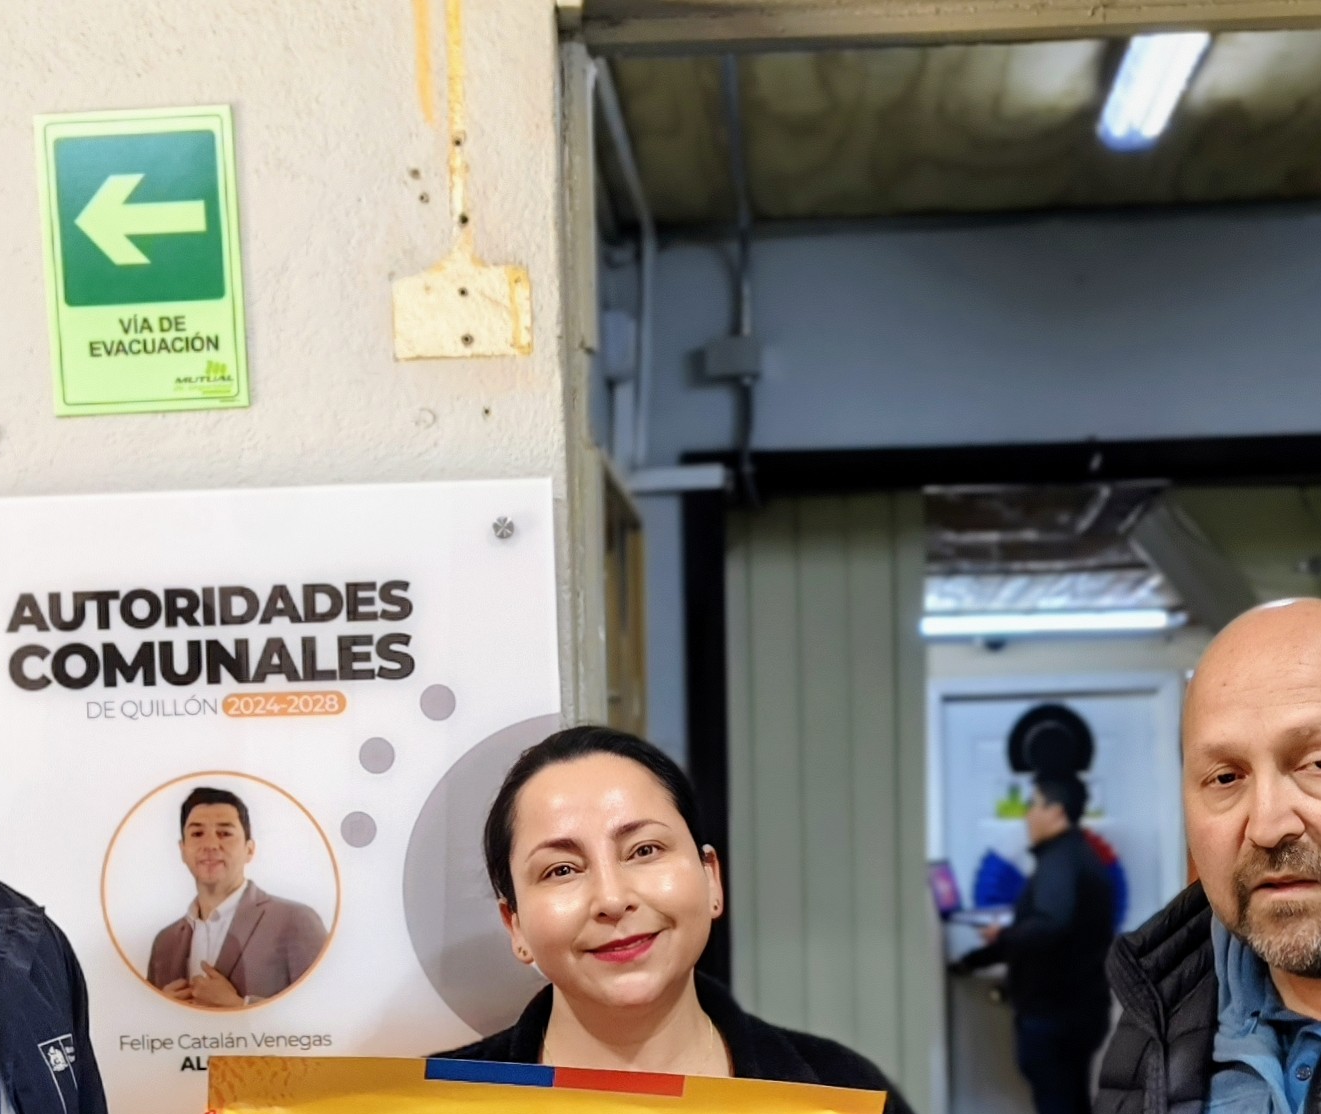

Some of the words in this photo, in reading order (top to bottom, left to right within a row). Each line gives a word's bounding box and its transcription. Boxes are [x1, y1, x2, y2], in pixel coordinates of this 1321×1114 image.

[118, 315, 154, 335] VÍA
[159, 315, 187, 333] DE
[88, 332, 220, 358] EVACUACIÓN
[5, 579, 415, 633] AUTORIDADES
[7, 632, 417, 692] COMUNALES
[86, 700, 116, 720] DE
[120, 694, 218, 719] QUILLÓN
[227, 694, 341, 715] 2024-2028
[119, 1034, 174, 1054] Felipe
[177, 1032, 248, 1051] Catalán
[251, 1031, 332, 1051] Venegas
